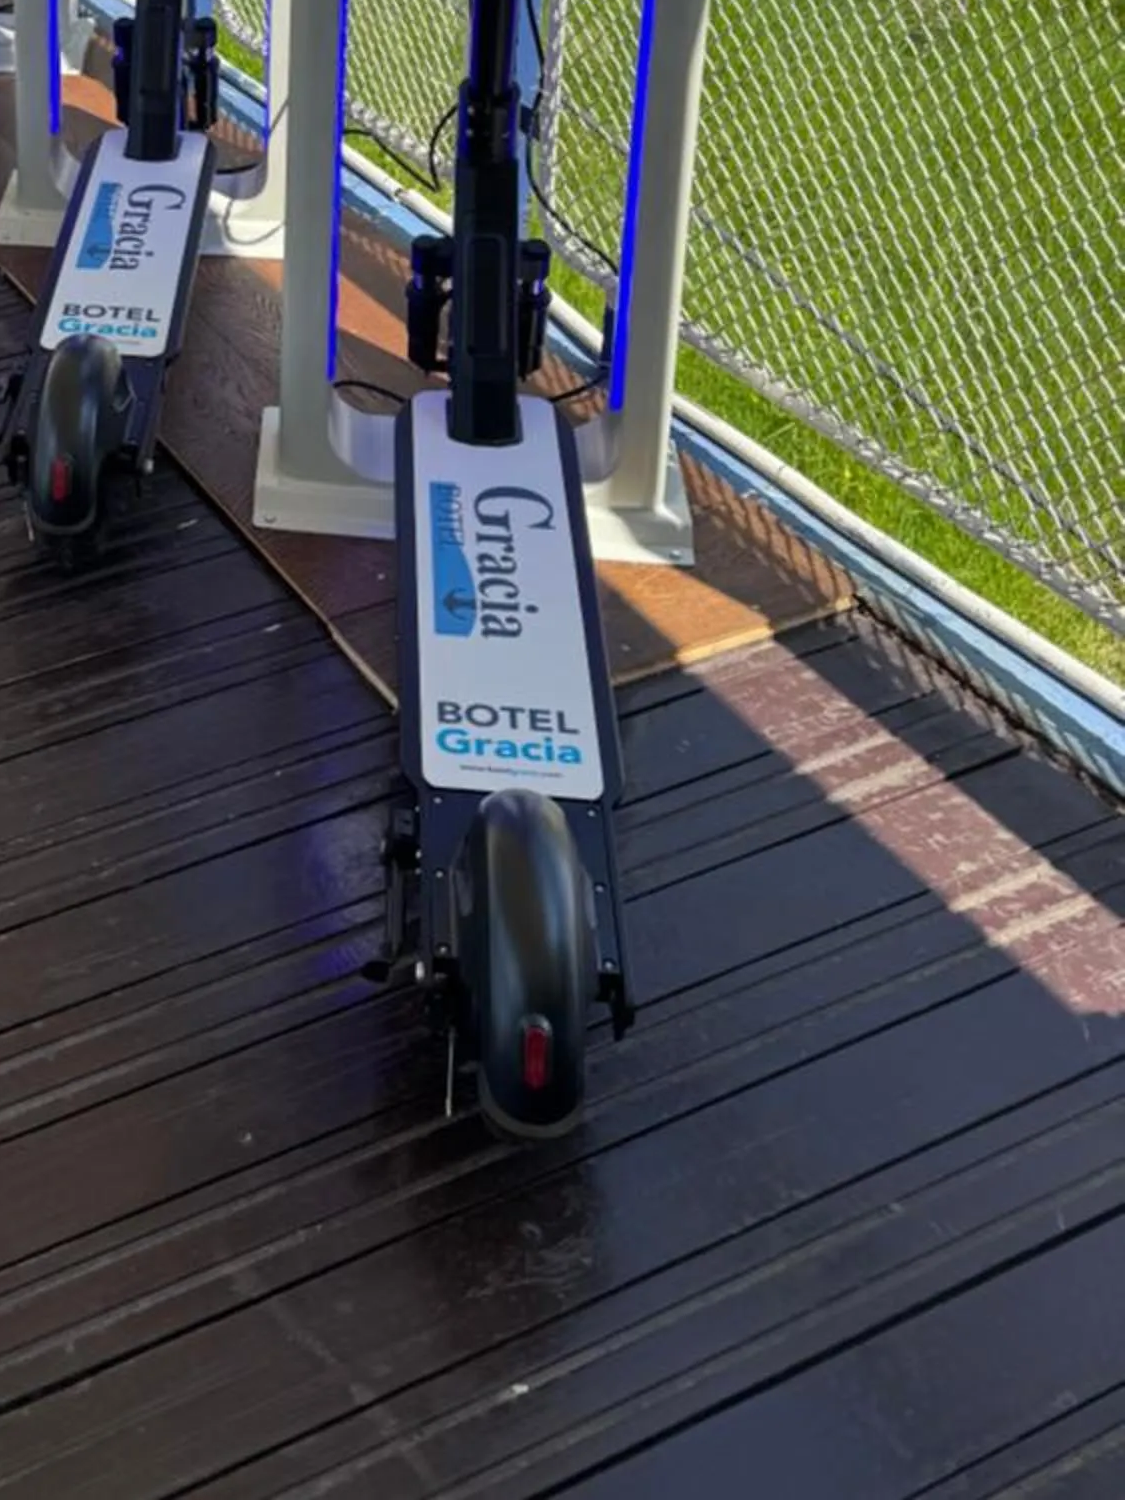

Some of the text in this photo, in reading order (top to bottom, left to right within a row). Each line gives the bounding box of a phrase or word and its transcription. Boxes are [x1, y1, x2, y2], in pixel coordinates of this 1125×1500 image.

[109, 184, 186, 271] Gracia
[58, 317, 157, 338] Gracia
[62, 303, 161, 322] BOTEL
[474, 486, 556, 638] Gracia
[437, 701, 580, 735] BOTEL
[435, 727, 583, 765] Gracia
